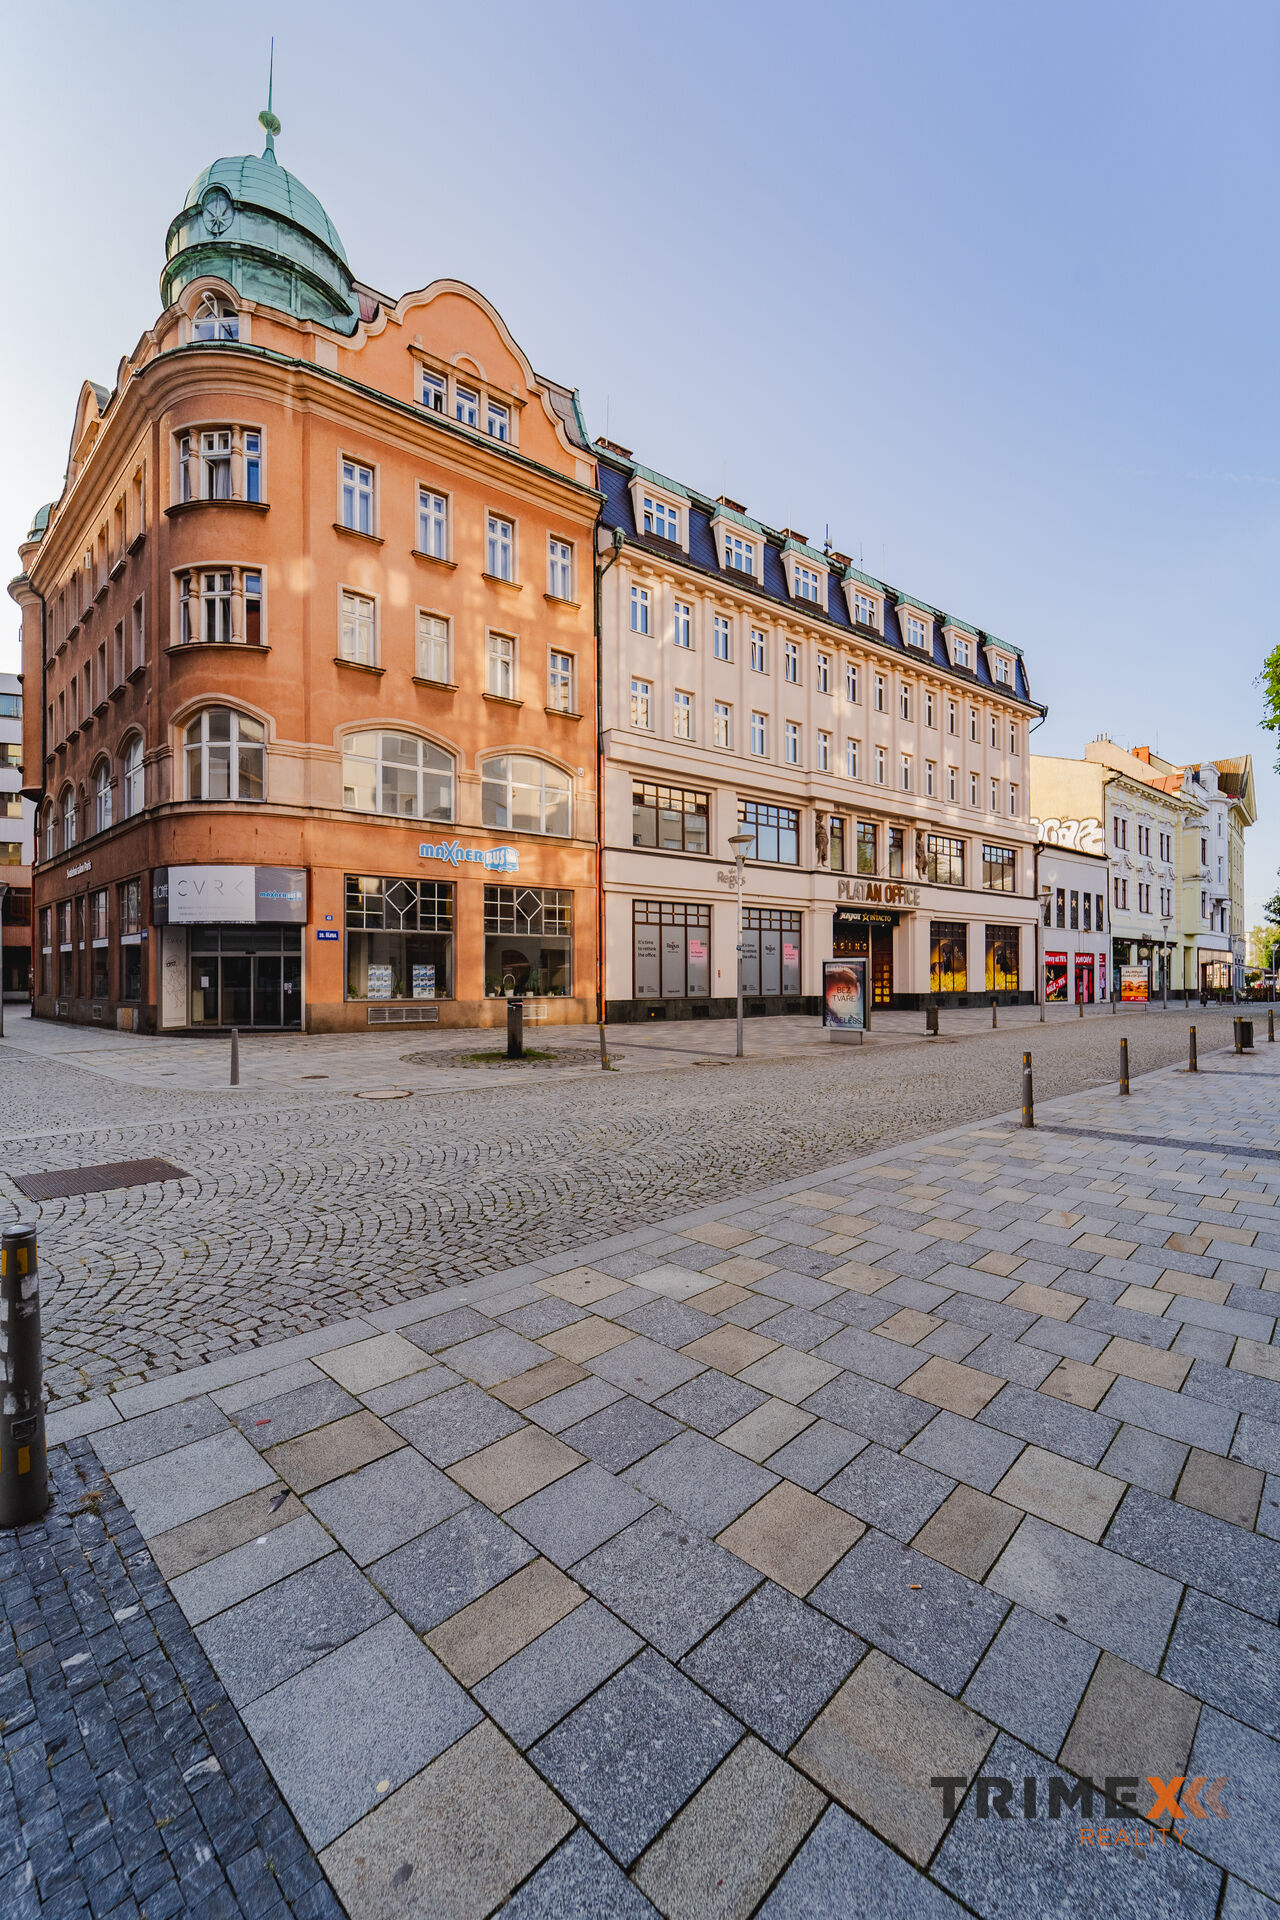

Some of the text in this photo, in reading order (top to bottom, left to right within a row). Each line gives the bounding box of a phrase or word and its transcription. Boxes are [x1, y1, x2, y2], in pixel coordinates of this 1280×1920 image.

[837, 880, 921, 906] PLATAN OFFICE
[833, 942, 867, 950] ASINO
